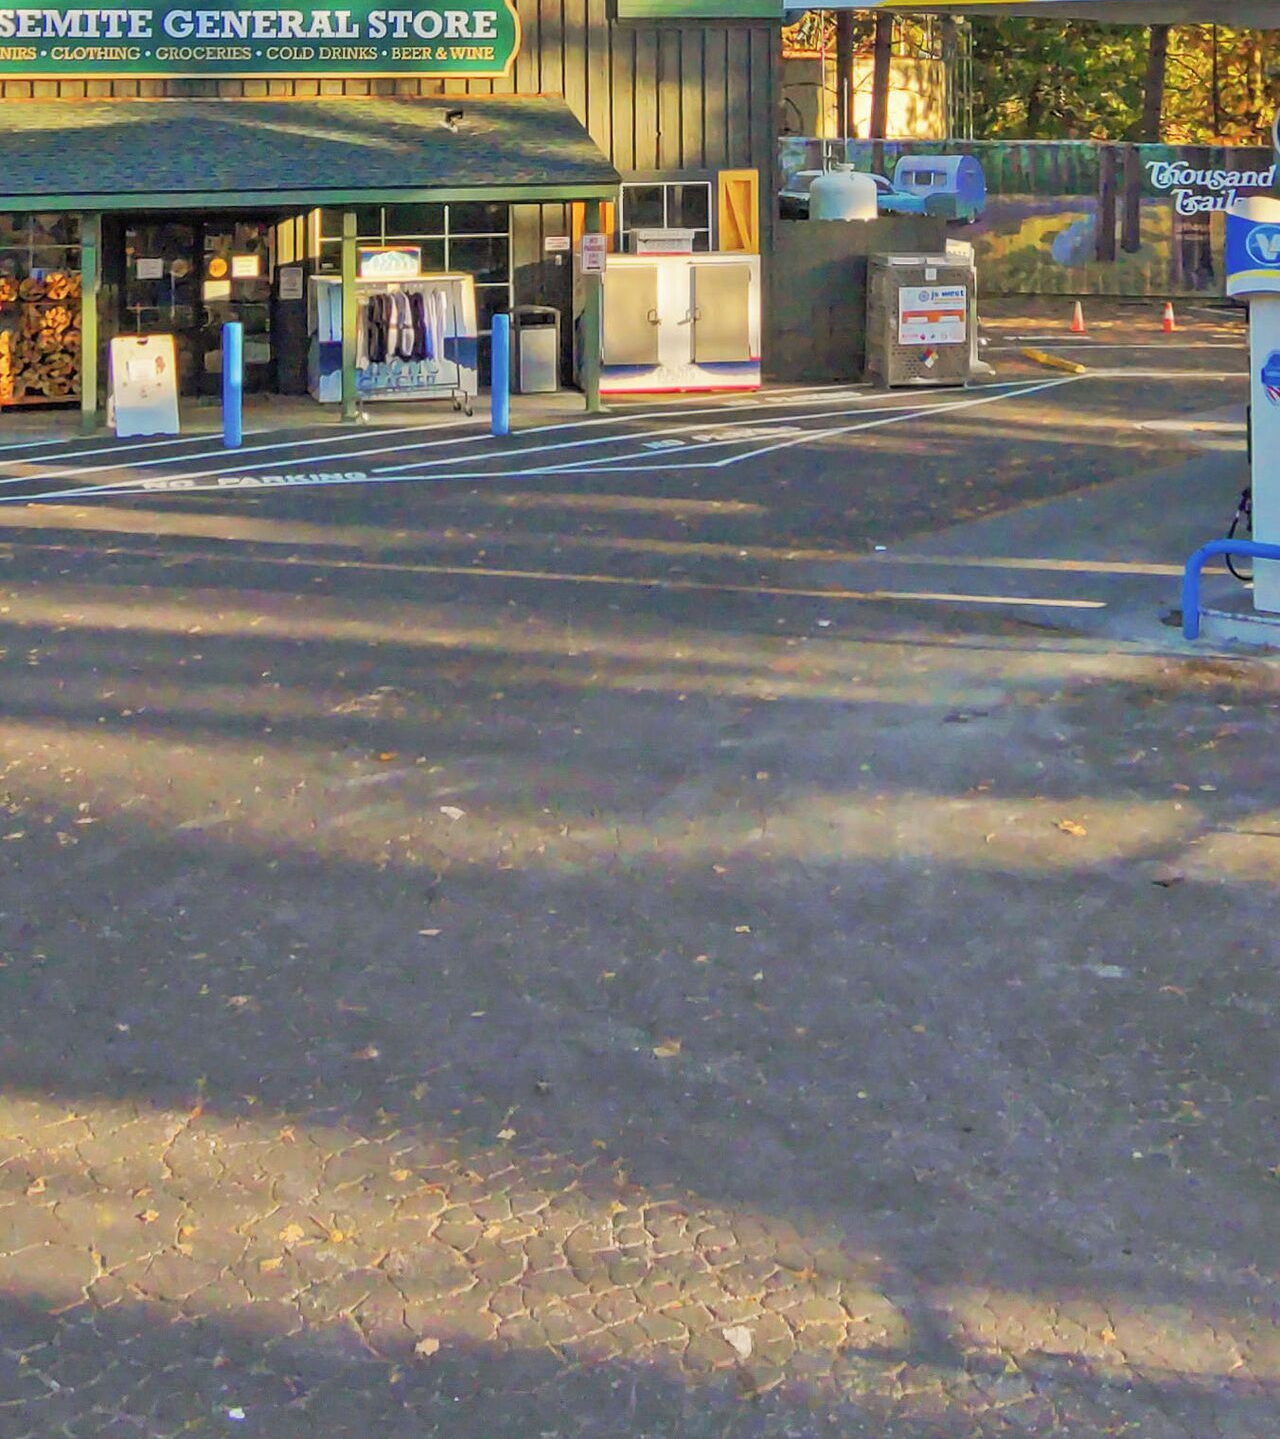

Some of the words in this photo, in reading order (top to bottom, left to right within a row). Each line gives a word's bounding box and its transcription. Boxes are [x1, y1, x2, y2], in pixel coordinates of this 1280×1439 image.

[163, 9, 360, 39] GENERAL
[369, 10, 497, 39] STORE
[51, 46, 141, 60] CLOTHING
[155, 46, 252, 60] GROCERIES
[266, 47, 315, 60] COLD
[319, 47, 378, 60] DRINKS
[391, 47, 431, 60] BEER
[435, 47, 448, 60] &
[449, 47, 494, 60] WINE
[1145, 160, 1277, 189] Thousand
[1170, 189, 1247, 216] Trail
[217, 471, 368, 487] PARKING
